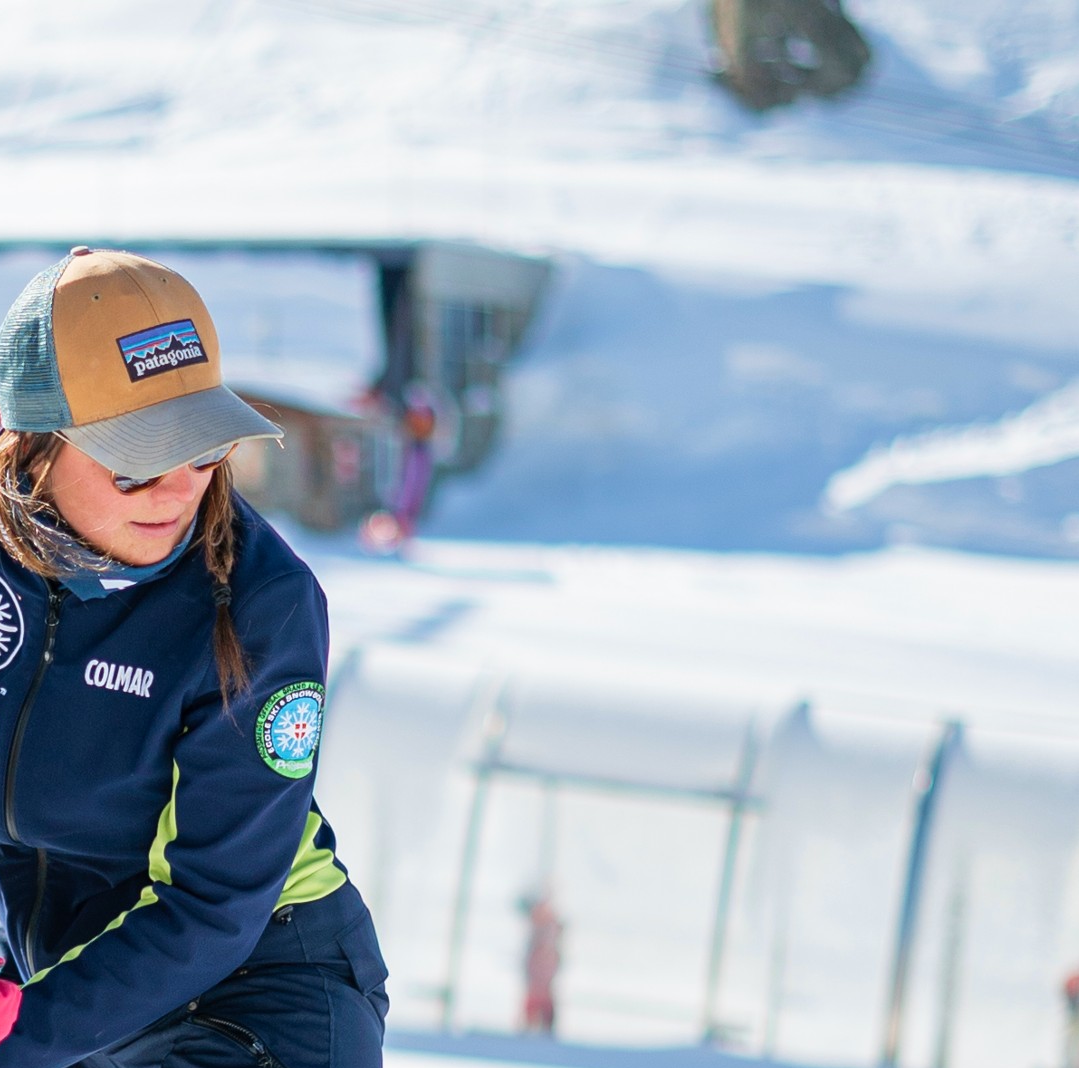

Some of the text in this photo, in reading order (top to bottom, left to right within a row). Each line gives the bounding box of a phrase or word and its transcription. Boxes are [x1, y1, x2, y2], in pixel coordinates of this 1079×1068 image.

[133, 344, 202, 376] patagonia
[84, 658, 155, 698] COLMAR
[267, 705, 280, 722] SKI
[264, 722, 275, 754] ECOLE
